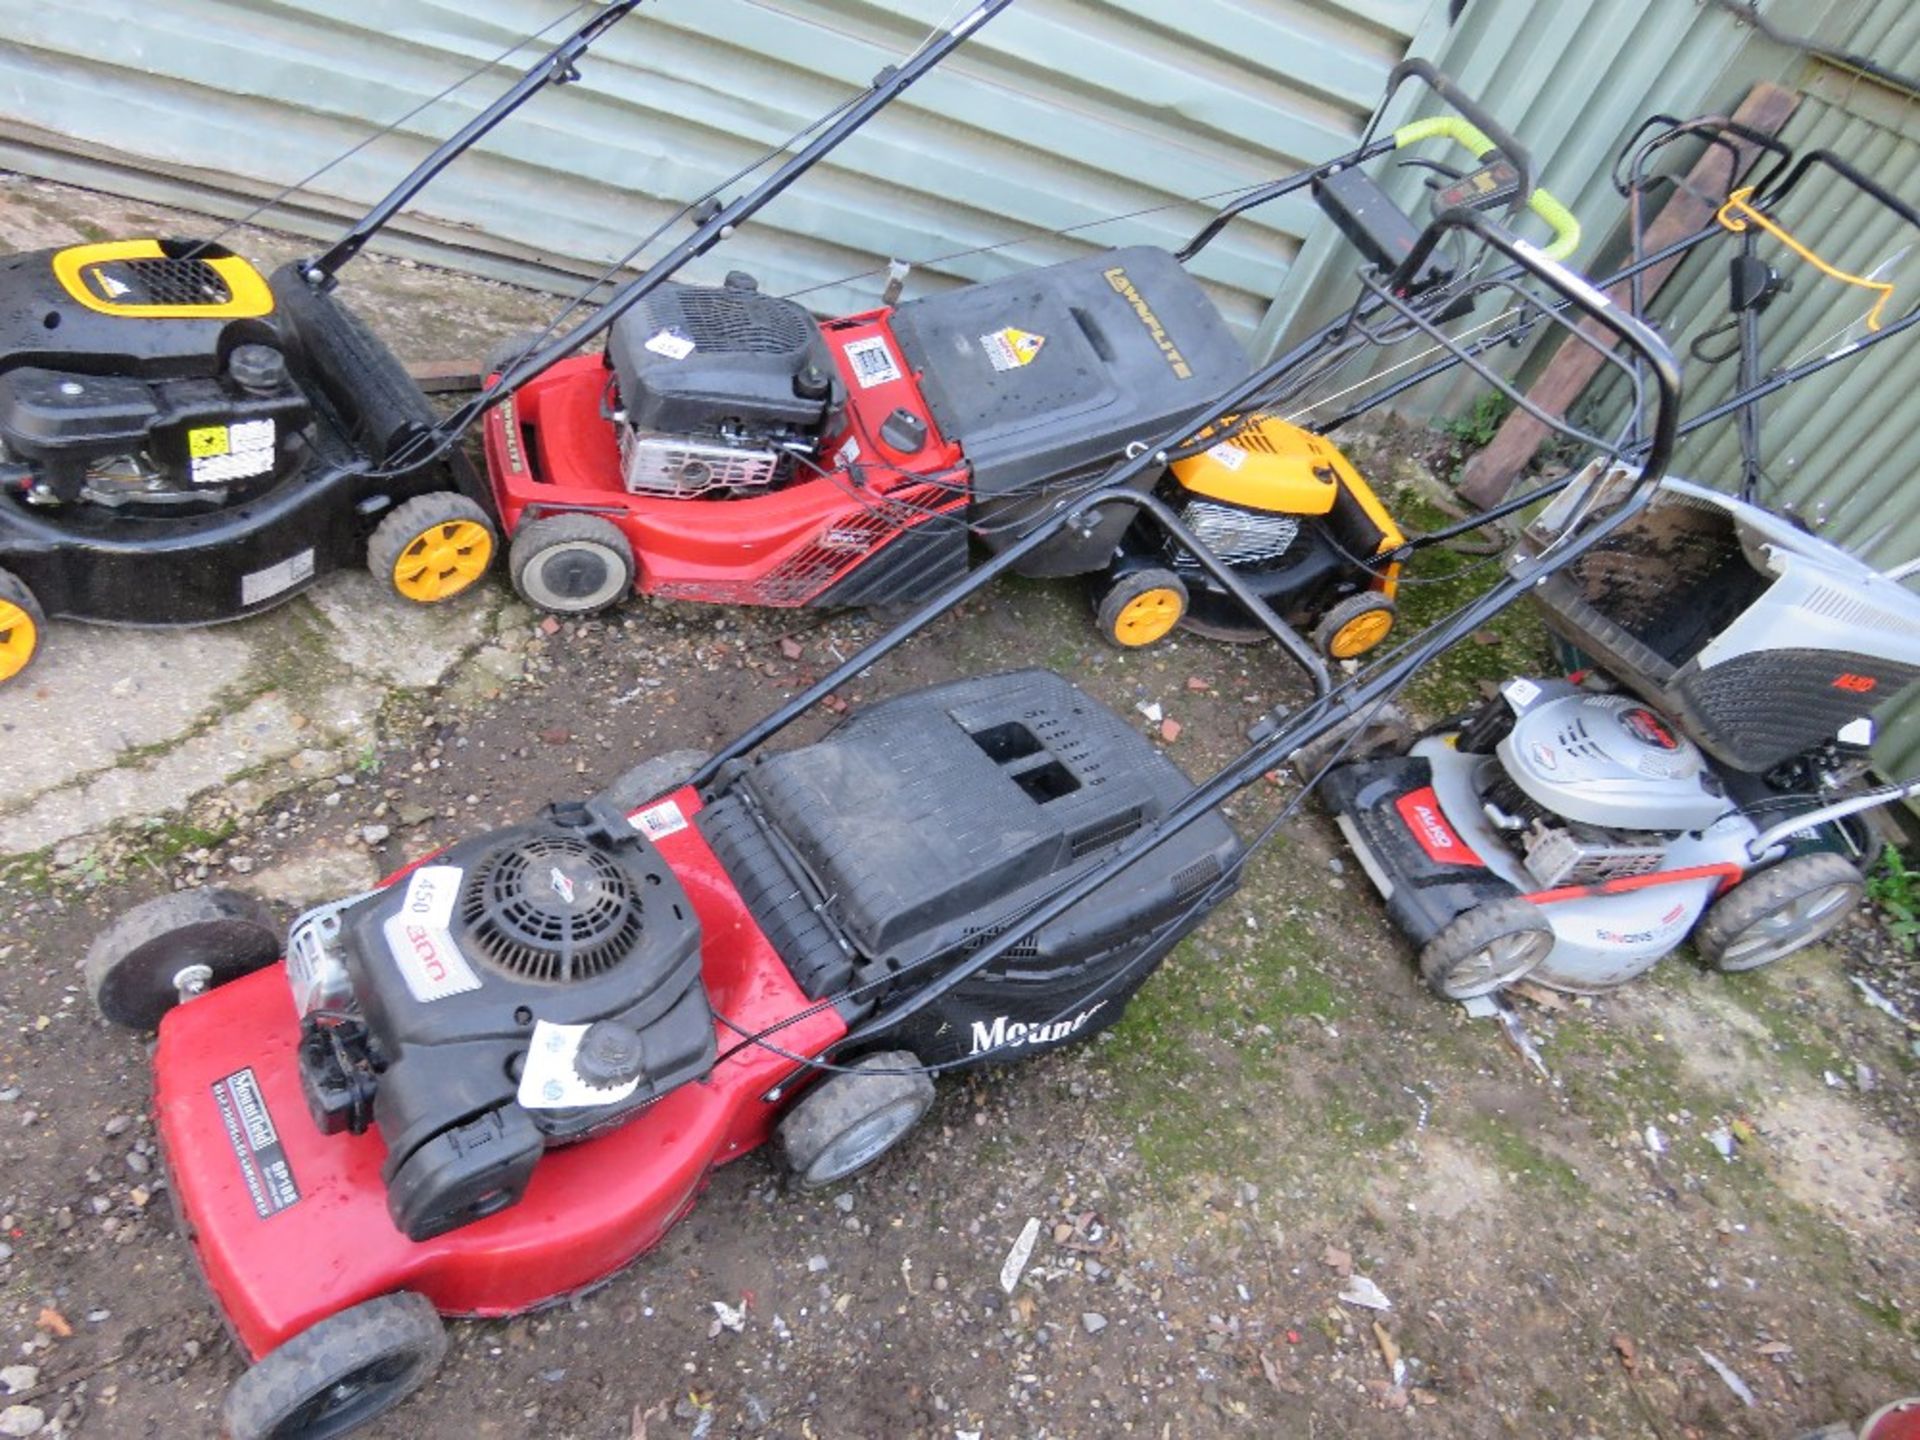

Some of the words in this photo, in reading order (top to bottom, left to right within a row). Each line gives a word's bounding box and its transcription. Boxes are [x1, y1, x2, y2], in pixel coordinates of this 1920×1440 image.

[500, 396, 523, 473] AWNFLITE
[411, 878, 433, 913] 450
[231, 1074, 272, 1146] Mountfield
